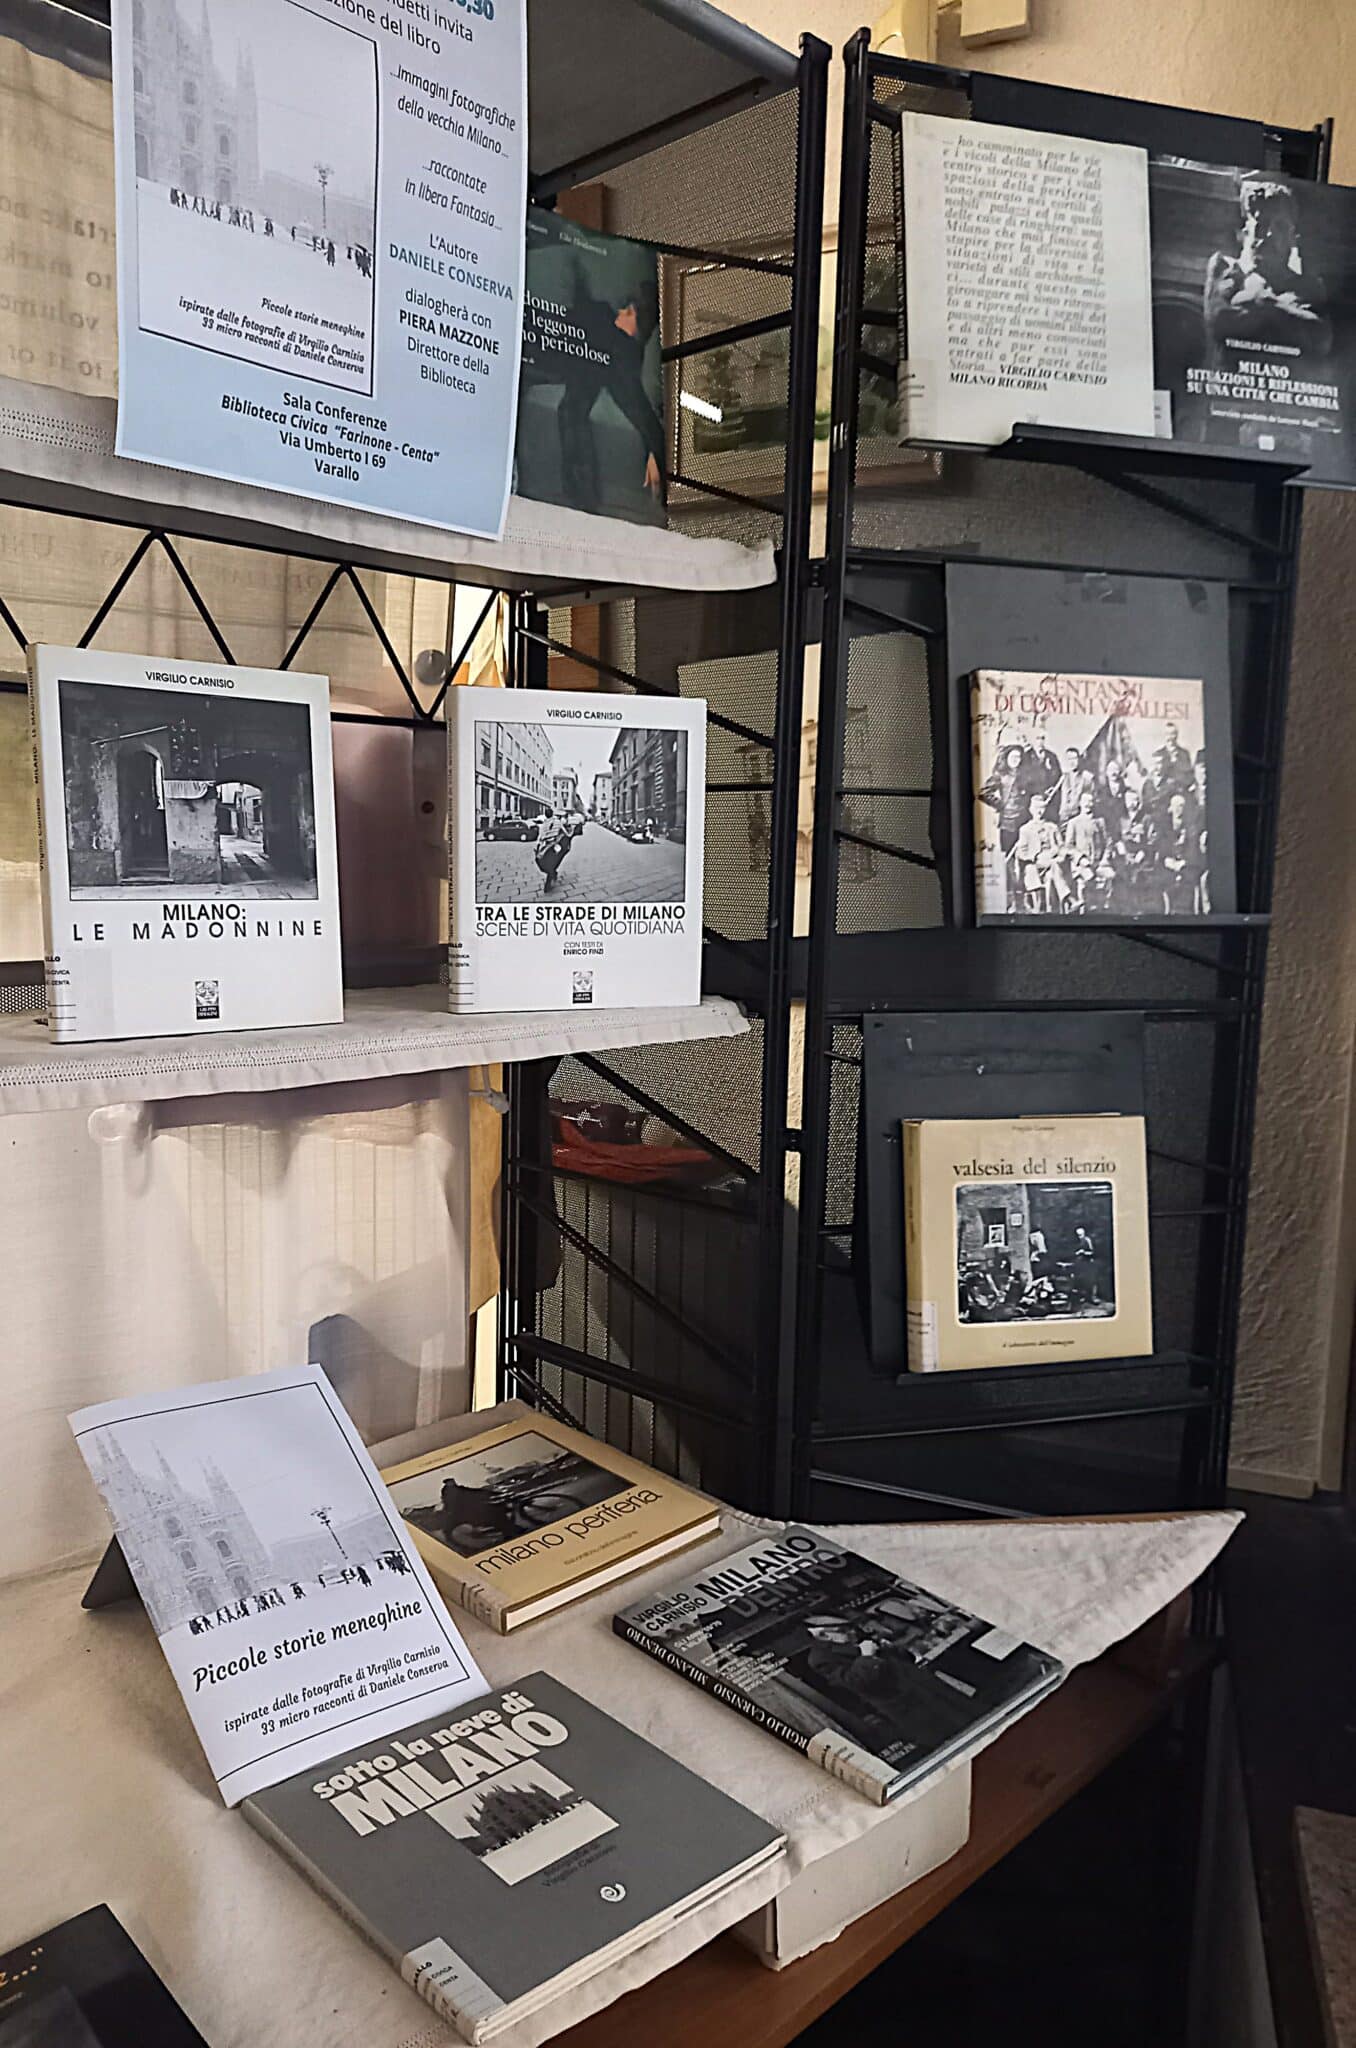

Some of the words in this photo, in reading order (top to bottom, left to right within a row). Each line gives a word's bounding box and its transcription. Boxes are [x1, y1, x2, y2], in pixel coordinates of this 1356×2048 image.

[380, 13, 403, 37] del
[407, 24, 441, 54] libro
[387, 0, 430, 21] detti
[434, 9, 473, 41] invita
[398, 95, 424, 119] della
[427, 110, 464, 137] vecchia
[450, 90, 516, 131] fotografiche
[943, 161, 982, 172] centro
[987, 166, 1027, 179] storico
[1001, 154, 1031, 168] della
[1037, 159, 1079, 173] Milano
[405, 178, 416, 196] in
[418, 182, 448, 208] libera
[1002, 178, 1034, 192] della
[946, 220, 990, 235] Milano
[995, 226, 1016, 238] che
[430, 233, 478, 264] L'Autore
[390, 243, 445, 276] DANIELE
[448, 266, 513, 300] CONSERVA
[261, 298, 292, 318] Piccole
[294, 309, 318, 325] storie
[320, 318, 365, 339] meneghine
[405, 288, 468, 321] dialogherà
[472, 312, 492, 329] con
[532, 309, 585, 340] leggono
[179, 296, 214, 317] ispirate
[216, 309, 239, 325] dalle
[241, 315, 285, 339] fotografie
[287, 329, 297, 341] di
[299, 334, 330, 352] Virgilio
[331, 344, 365, 363] Carnisio
[202, 317, 214, 329] 33
[216, 323, 243, 338] micro
[244, 333, 280, 350] racconti
[283, 341, 292, 353] di
[294, 344, 326, 364] Daniele
[327, 355, 365, 374] Conserva
[400, 309, 436, 334] PIERA
[439, 323, 499, 355] MAZZONE
[408, 336, 460, 366] Direttore
[462, 355, 489, 375] della
[541, 335, 610, 365] pericolose
[420, 365, 476, 394] Biblioteca
[949, 372, 996, 386] MILANO
[998, 377, 1048, 391] RICORDA
[1000, 364, 1051, 379] VIRGILIO
[1054, 370, 1107, 386] CARNISIO
[1187, 368, 1256, 387] SITUAZIONI
[1258, 377, 1266, 389] E
[1268, 378, 1338, 398] RIFLESSIONI
[1238, 360, 1290, 379] MILANO
[283, 392, 312, 412] Sala
[315, 400, 388, 432] Conferenze
[1187, 382, 1202, 394] SU
[1205, 383, 1229, 397] UNA
[1269, 391, 1293, 405] CHE
[1295, 394, 1340, 410] CAMBIA
[221, 395, 287, 425] Biblioteca
[290, 414, 328, 435] Civica
[279, 430, 300, 448] Via
[304, 437, 362, 463] Umberto
[365, 452, 368, 465] I
[372, 454, 386, 469] 69
[314, 458, 360, 482] Varallo
[145, 671, 187, 684] VIRGILIO
[189, 676, 235, 689] CARNISIO
[547, 709, 582, 719] VIRGILIO
[583, 711, 622, 720] CARNISIO
[994, 694, 1014, 712] DI
[162, 903, 247, 921] MILANO:
[475, 907, 507, 921] TRA
[513, 907, 530, 921] LE
[535, 906, 596, 920] STRADE
[601, 906, 617, 920] DI
[623, 905, 686, 919] MILANO
[73, 923, 105, 941] LE
[132, 920, 323, 940] MADONNINE
[476, 922, 528, 937] SCENE
[533, 922, 548, 936] DI
[553, 921, 586, 936] VITA
[590, 920, 685, 936] QUOTIDIANA
[953, 1158, 1014, 1176] valsesia
[1023, 1157, 1047, 1174] del
[1057, 1156, 1116, 1174] silenzio
[474, 1532, 564, 1575] milano
[564, 1486, 664, 1540] periferia
[694, 1536, 817, 1599] MILANO
[720, 1550, 847, 1618] DENTRO
[632, 1593, 690, 1622] VIRGILIO
[646, 1597, 707, 1631] CARNISIO
[192, 1646, 269, 1692] Piccole
[273, 1628, 327, 1660] storie
[331, 1599, 423, 1642] meneghine
[626, 1627, 667, 1659] DENTRO
[667, 1655, 708, 1685] MILANO
[224, 1704, 270, 1733] ispirate
[272, 1691, 299, 1712] dalle
[300, 1672, 353, 1703] fotografie
[355, 1667, 366, 1681] di
[366, 1656, 402, 1678] Virgilio
[403, 1644, 441, 1665] Carnisio
[260, 1719, 276, 1736] 33
[278, 1708, 311, 1729] micro
[313, 1691, 356, 1718] racconti
[357, 1684, 368, 1699] di
[369, 1672, 406, 1695] Daniele
[406, 1658, 449, 1683] Conserva
[713, 1683, 766, 1722] CARNISIO
[312, 1754, 398, 1801] sotto
[390, 1737, 434, 1760] la
[429, 1708, 503, 1746] neve
[501, 1691, 535, 1715] di
[766, 1717, 808, 1749] RGILIO
[328, 1711, 569, 1837] MILANO
